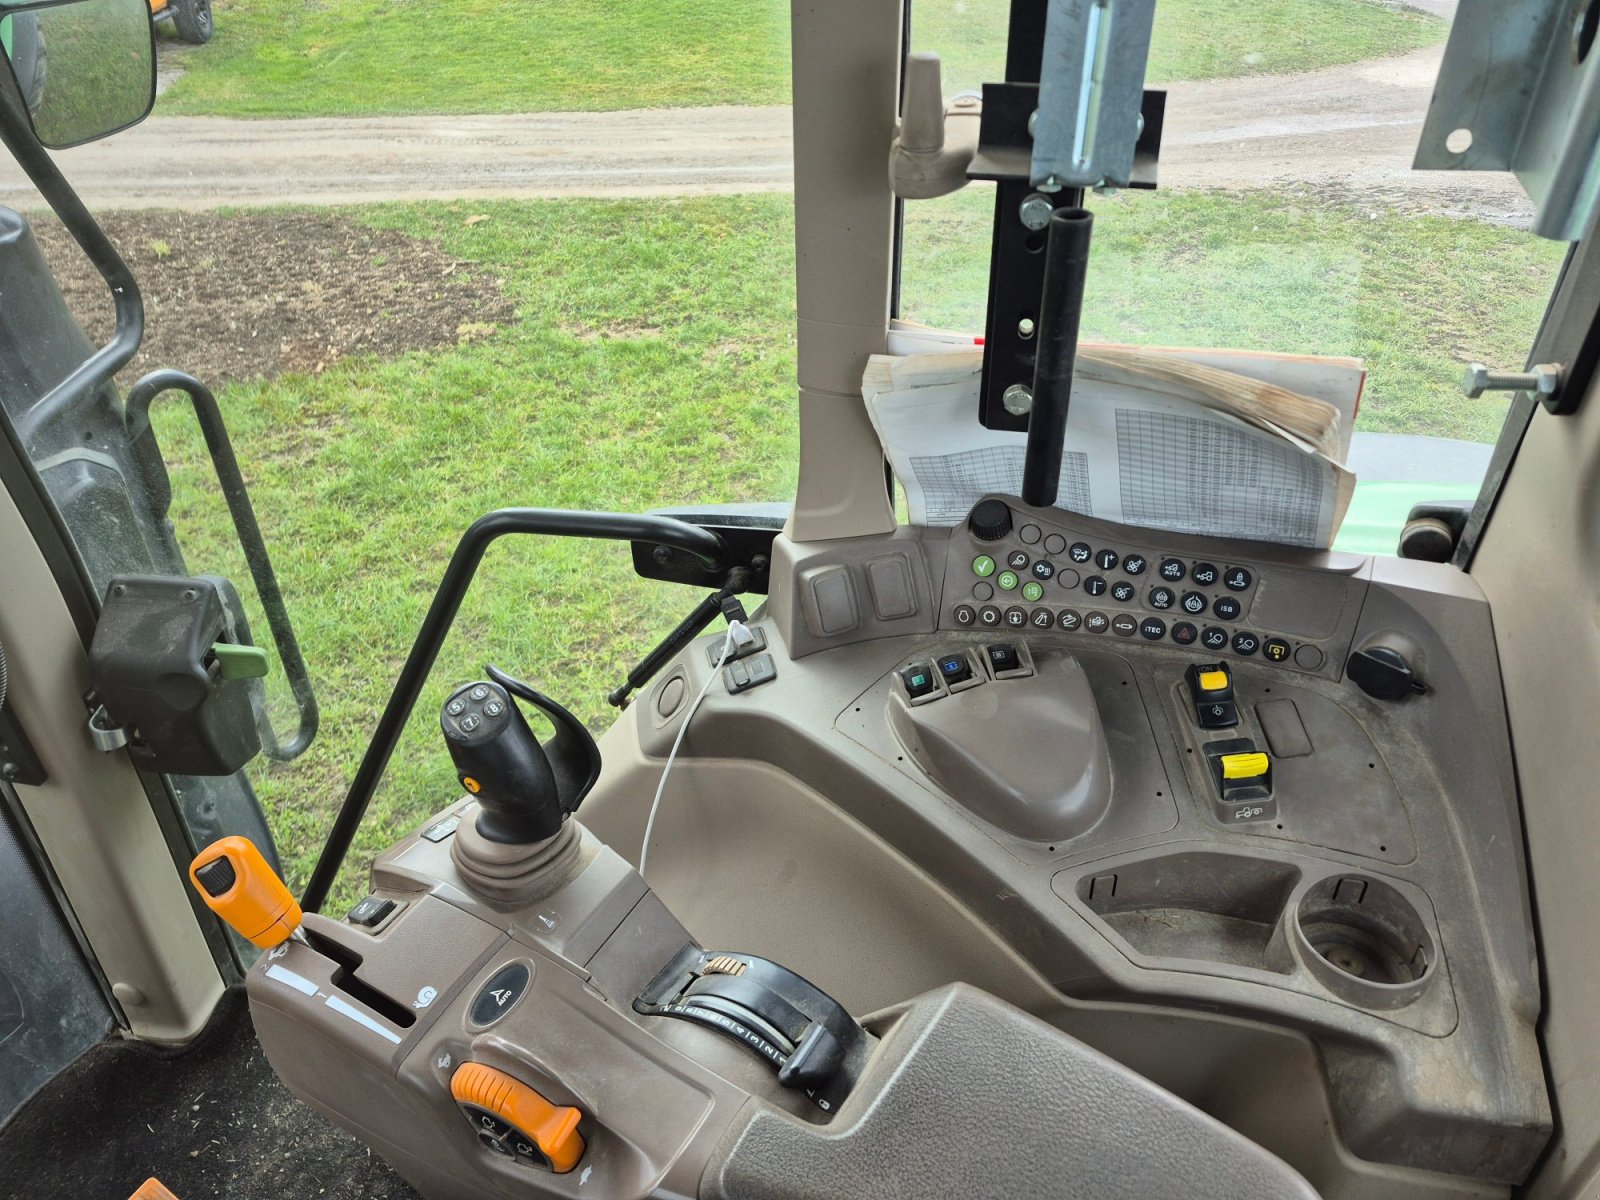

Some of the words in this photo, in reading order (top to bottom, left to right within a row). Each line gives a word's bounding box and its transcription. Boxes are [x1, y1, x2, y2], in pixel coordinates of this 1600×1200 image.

[475, 689, 484, 697] 6
[452, 703, 460, 711] 5
[490, 704, 499, 713] 8
[465, 717, 474, 727] 7
[498, 990, 512, 1007] AUTO
[750, 1035, 759, 1044] 3
[764, 1045, 774, 1054] 2
